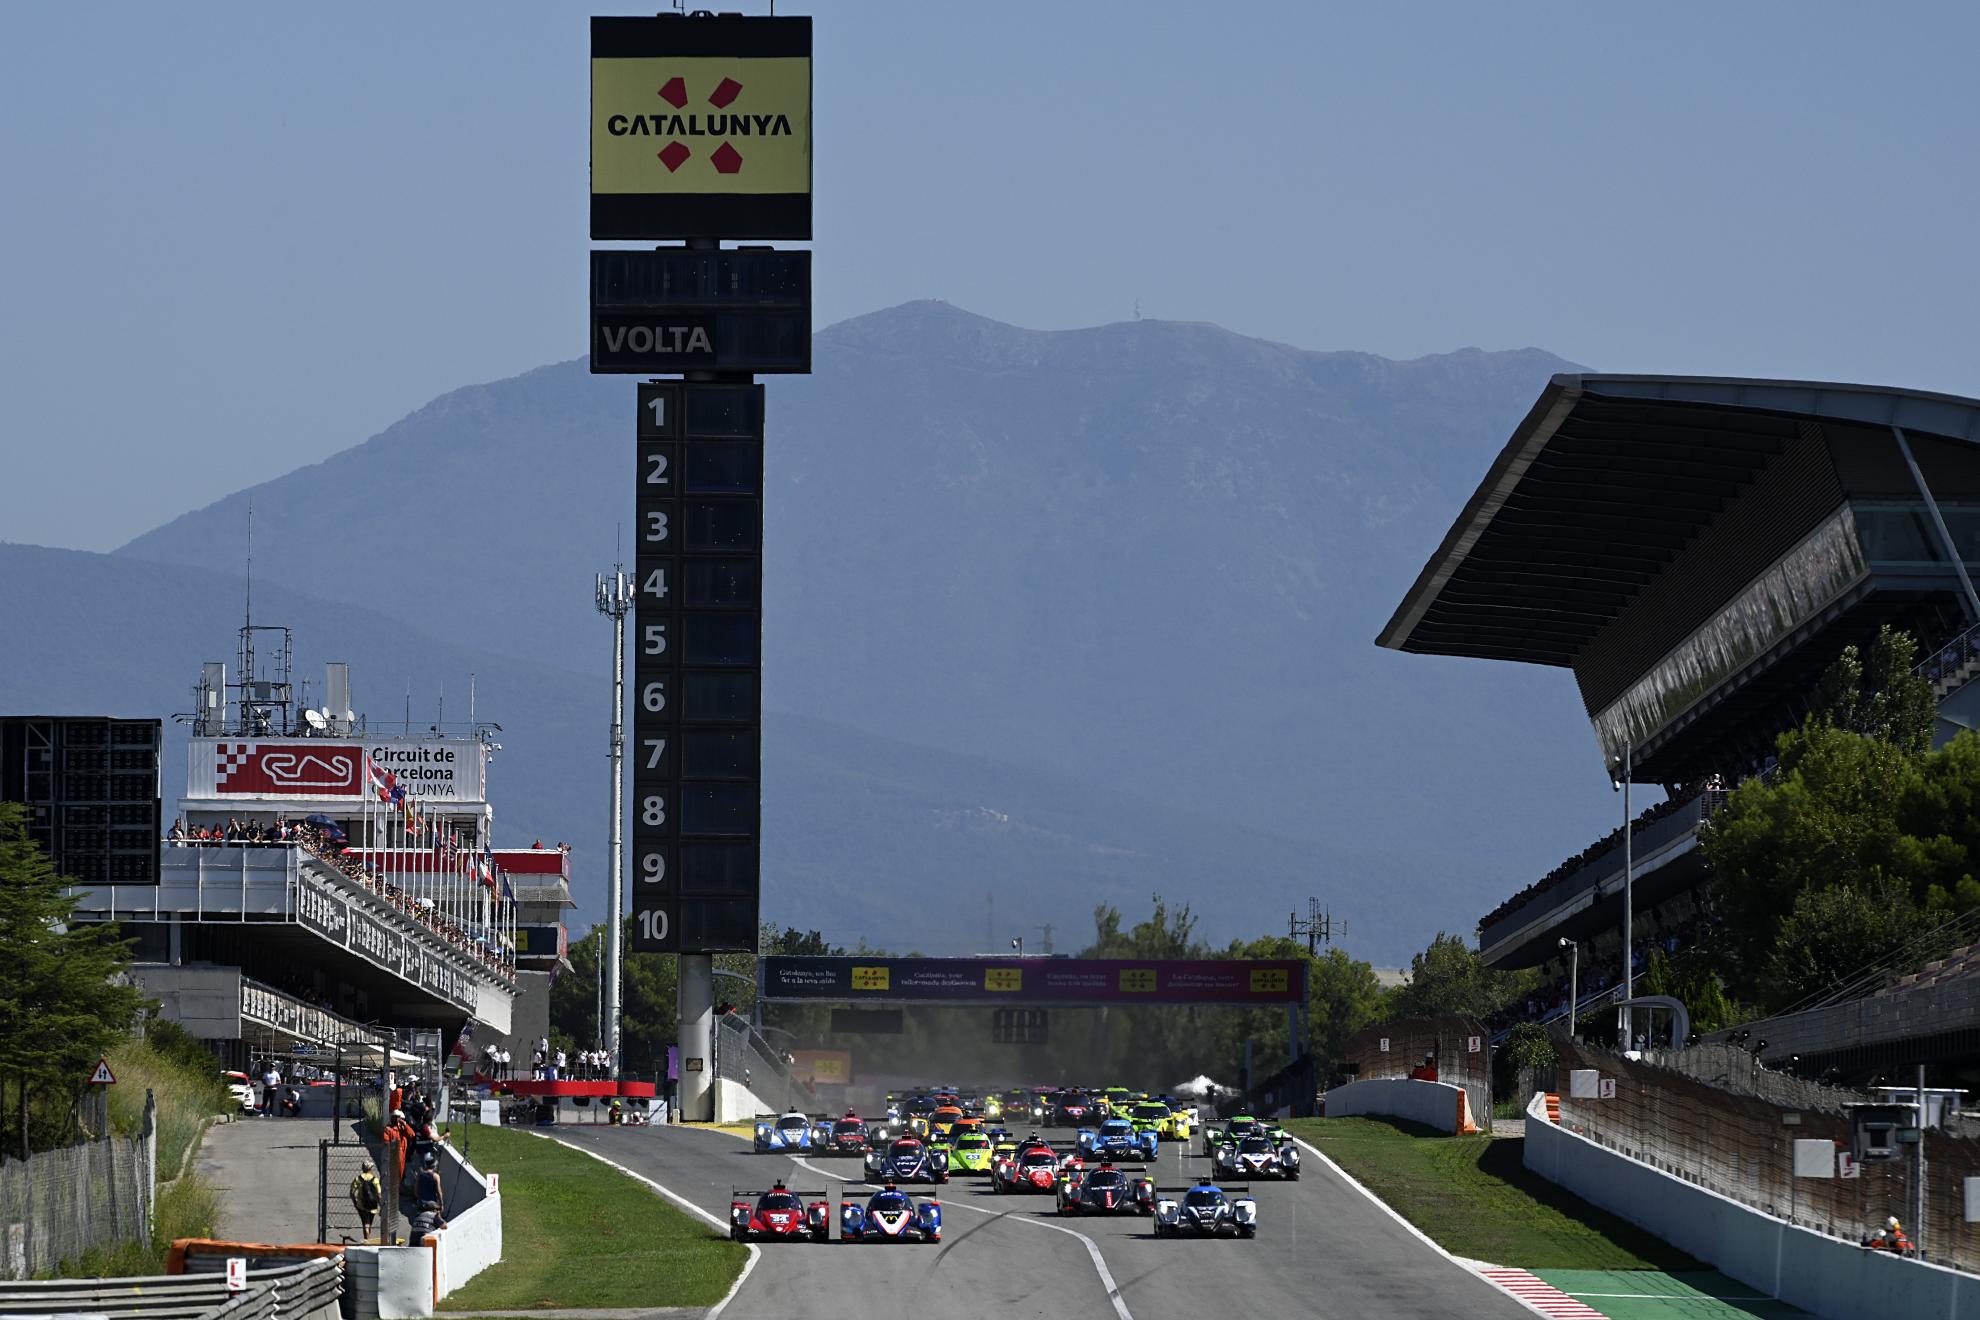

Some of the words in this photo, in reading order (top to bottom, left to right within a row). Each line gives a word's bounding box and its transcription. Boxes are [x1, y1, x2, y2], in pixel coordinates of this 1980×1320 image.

[607, 114, 792, 136] CATALUNYA
[602, 326, 713, 353] VOLTA
[648, 397, 665, 426] 1
[646, 454, 669, 484] 2
[646, 511, 669, 541] 3
[643, 568, 669, 598] 4
[645, 625, 667, 655] 5
[643, 682, 666, 711] 6
[372, 747, 431, 762] Circuit
[433, 747, 455, 762] de
[643, 739, 666, 769] 7
[384, 765, 454, 780] rcelona
[371, 783, 455, 796] LUNYA
[642, 795, 666, 826] 8
[642, 853, 666, 883] 9
[638, 909, 669, 940] 10
